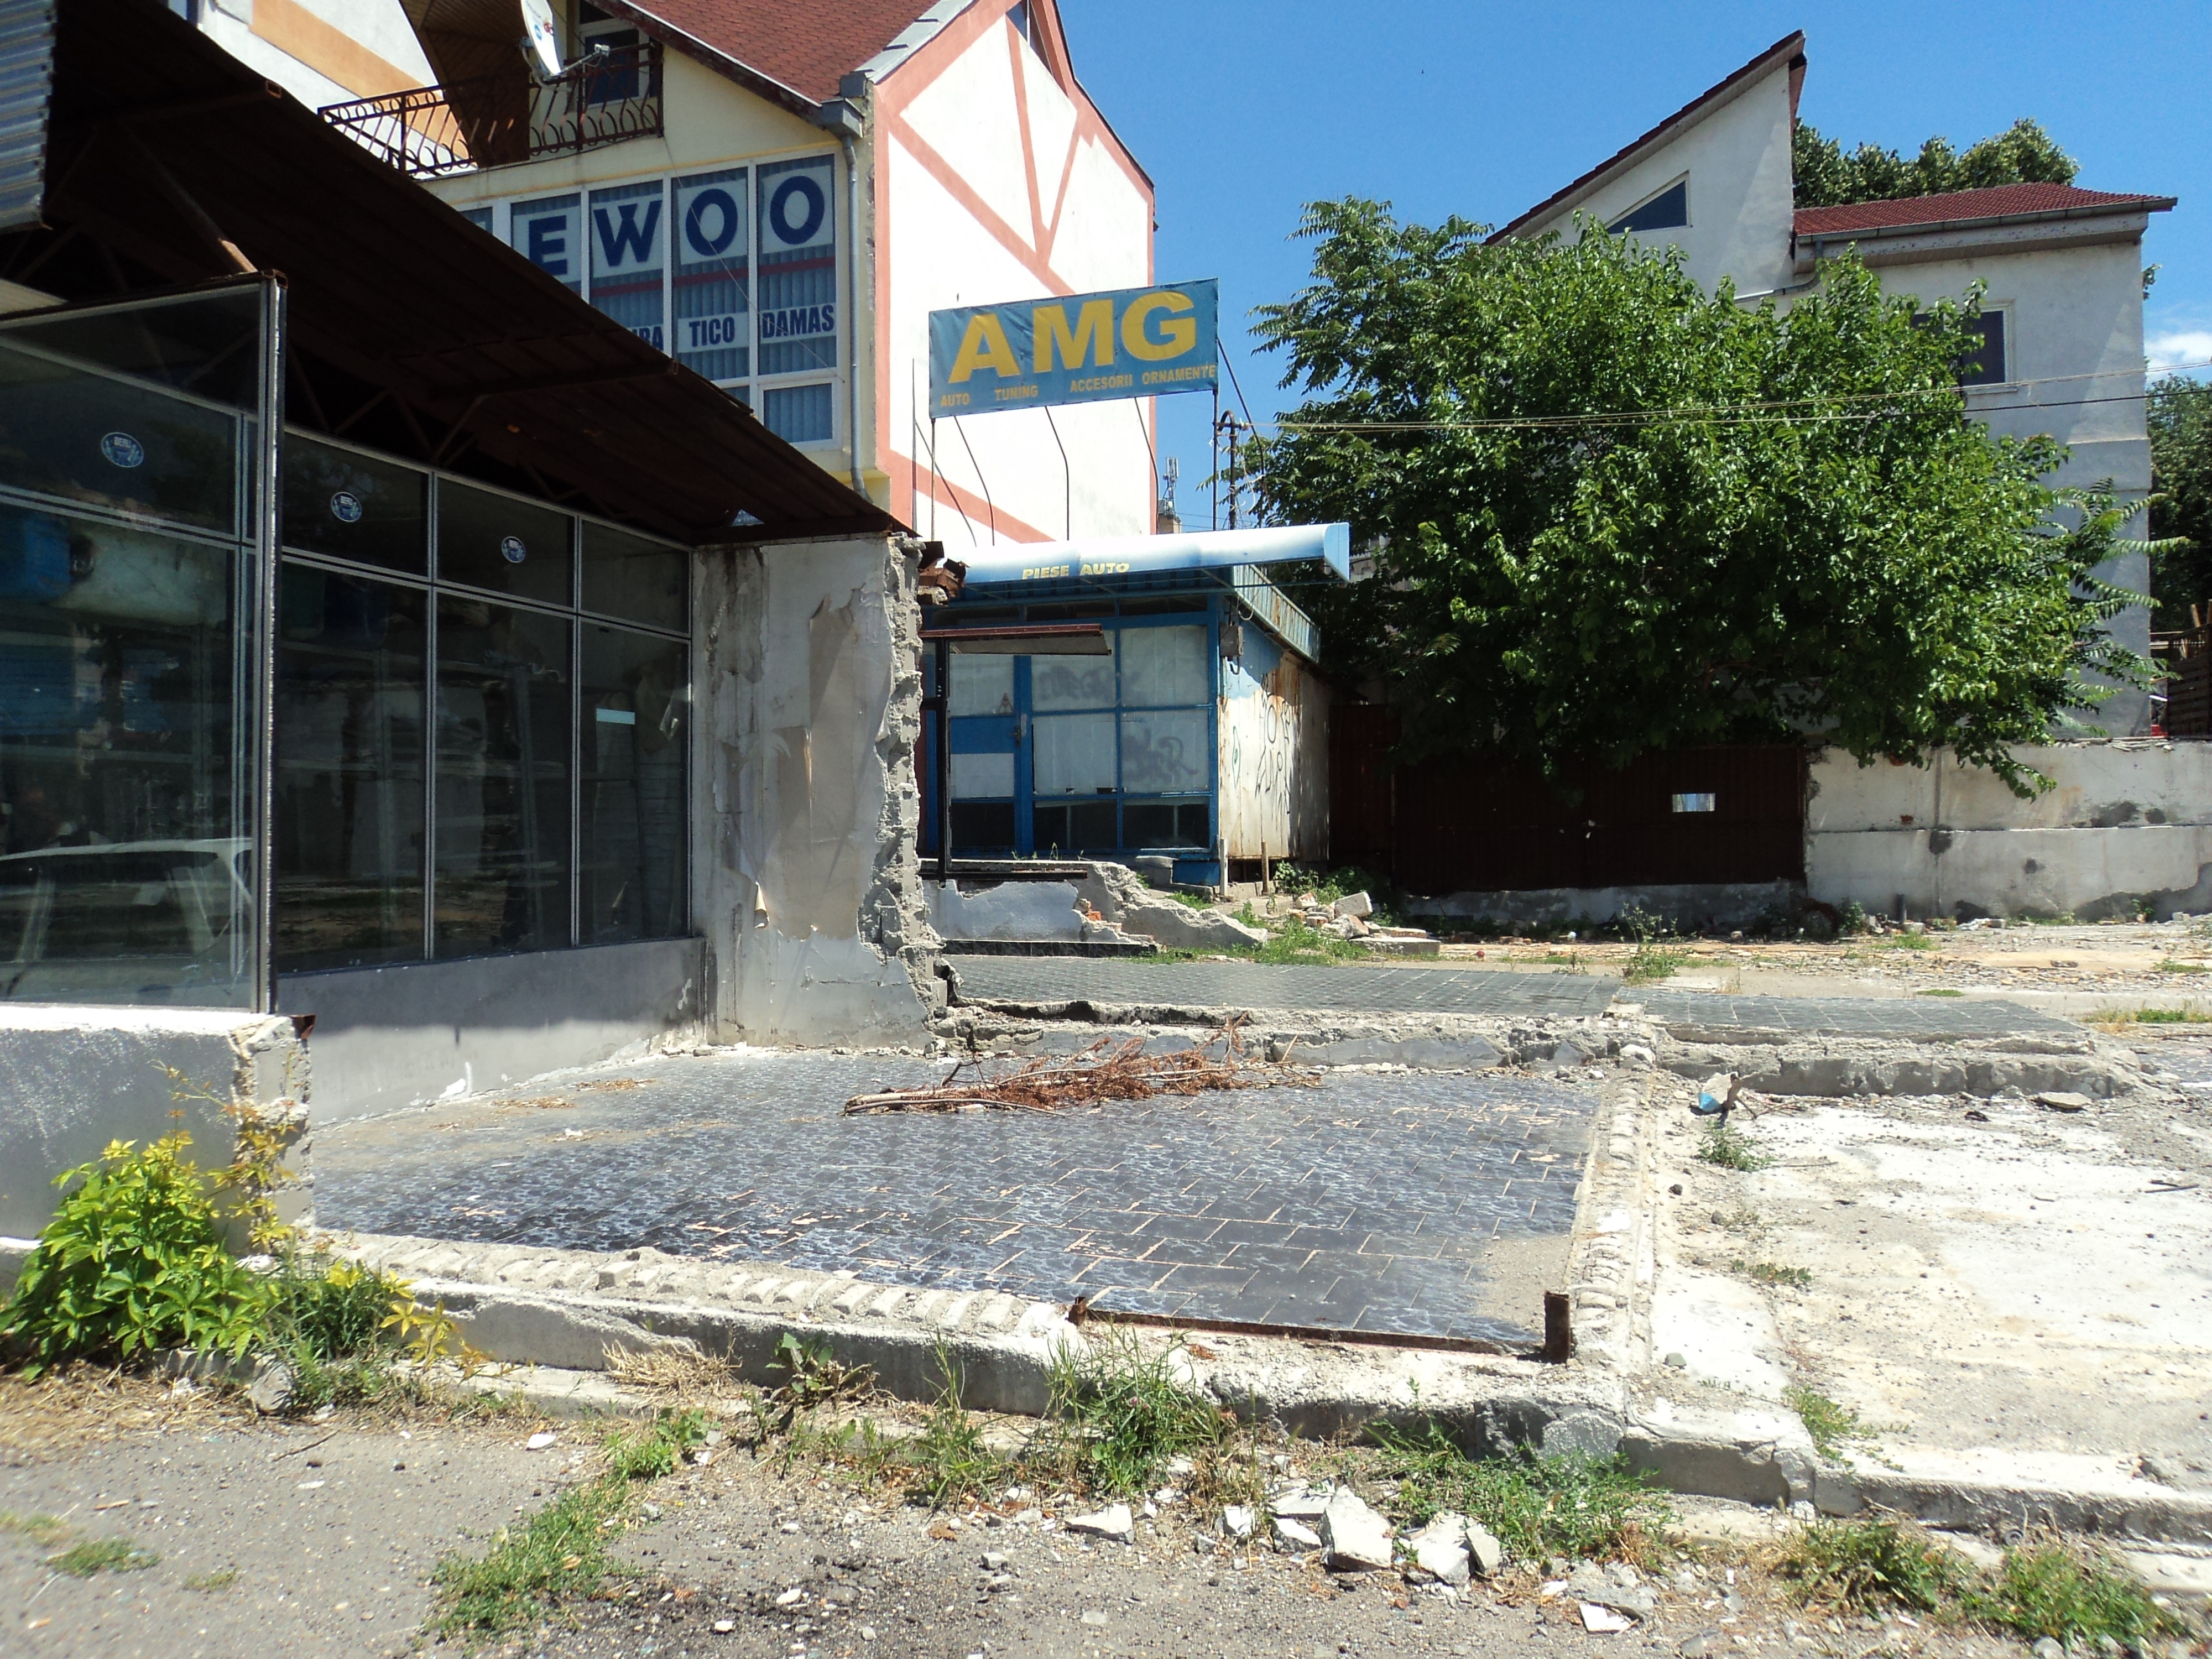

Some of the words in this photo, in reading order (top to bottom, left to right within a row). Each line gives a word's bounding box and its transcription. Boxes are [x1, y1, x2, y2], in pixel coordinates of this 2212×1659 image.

[688, 316, 735, 347] TICO
[762, 305, 834, 338] DAMAS
[948, 291, 1196, 383] AMG
[941, 393, 970, 407] AUTO
[995, 384, 1038, 401] TUNING
[1070, 374, 1133, 393] ACCESORII
[1142, 364, 1215, 384] ORNAMENTE
[1022, 565, 1070, 580] PIESE
[1079, 562, 1129, 575] AUTO
